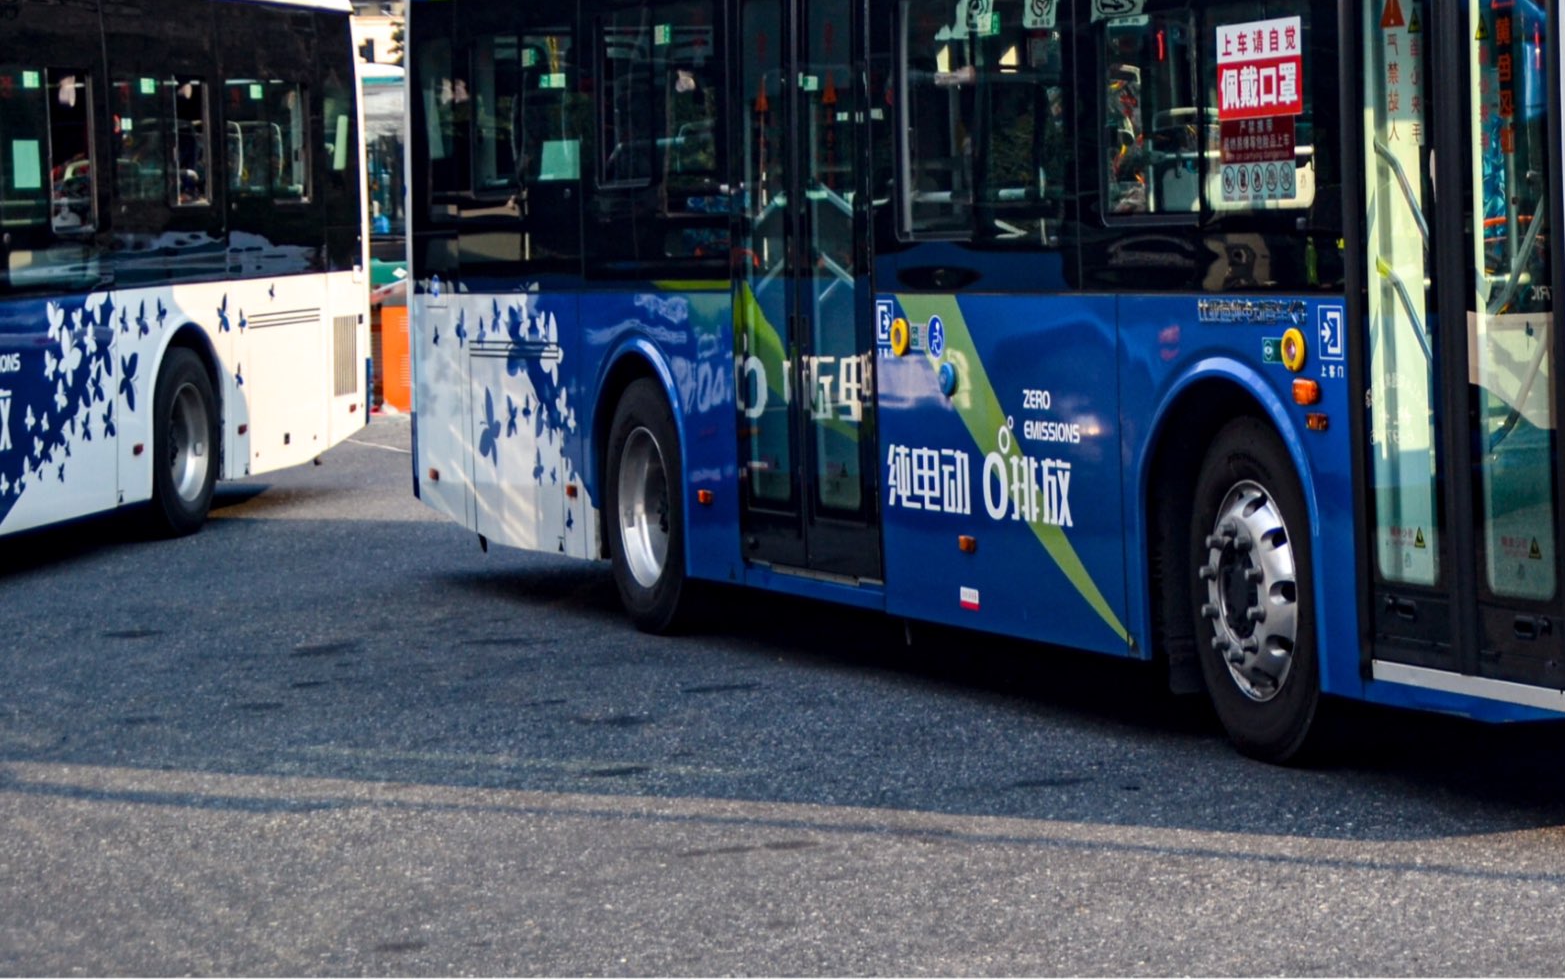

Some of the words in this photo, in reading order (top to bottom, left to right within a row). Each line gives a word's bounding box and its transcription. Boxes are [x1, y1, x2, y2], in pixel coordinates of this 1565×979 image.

[1221, 25, 1297, 57] 上车请自觉
[1220, 61, 1298, 111] 佩戴口罩
[1022, 389, 1050, 410] ZERO
[1023, 420, 1080, 444] EMISSIONS
[887, 444, 971, 515] 纯电动
